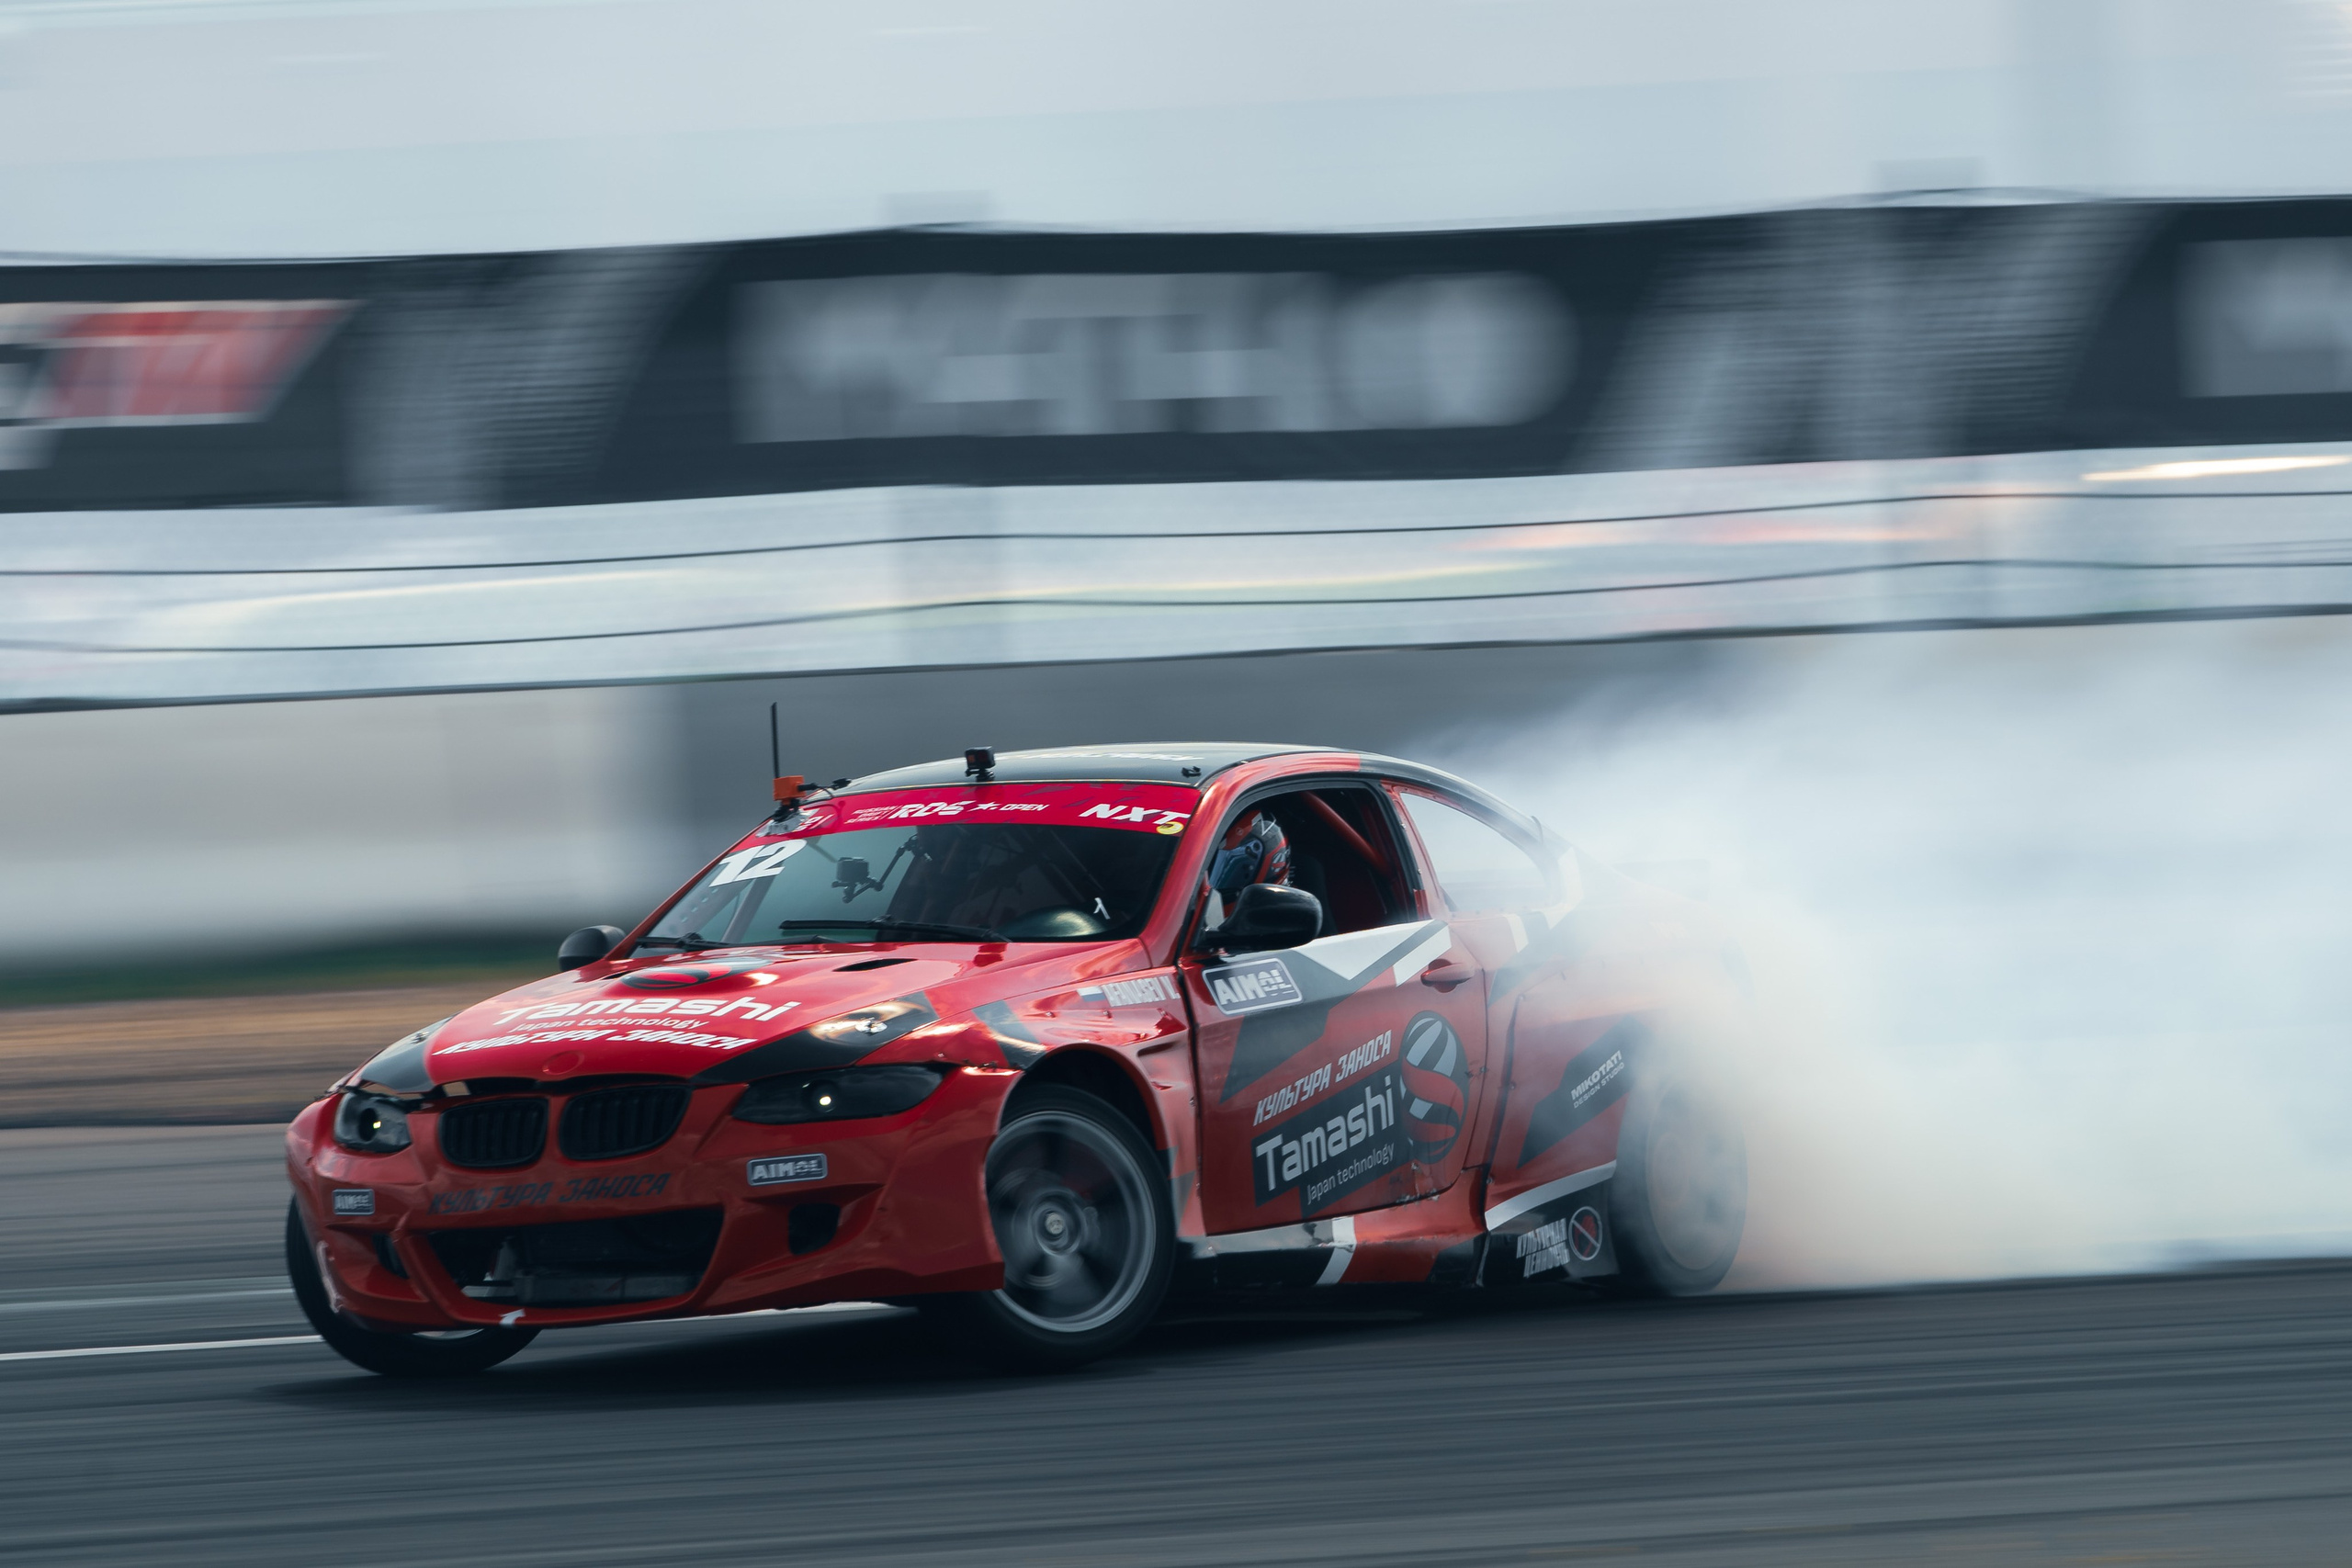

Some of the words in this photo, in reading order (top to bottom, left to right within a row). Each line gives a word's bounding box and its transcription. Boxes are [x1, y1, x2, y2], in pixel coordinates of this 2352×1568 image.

[888, 801, 977, 819] RDS
[999, 804, 1050, 812] OPEN
[1078, 804, 1192, 825] NXT
[708, 839, 807, 887] 12
[1212, 967, 1297, 1006] AIMOL
[492, 997, 802, 1026] Tamashi
[577, 1017, 710, 1030] technology
[605, 1029, 759, 1050] ЗАНОСА
[1253, 1062, 1333, 1127] КУЛЬТУРА
[1335, 1029, 1392, 1084] ЗАНОСА
[1570, 1050, 1623, 1100] MIKOTATI
[1573, 1083, 1601, 1109] DESIGN
[1600, 1062, 1625, 1087] STUDIO
[1255, 1075, 1395, 1192] Tamashi
[752, 1159, 823, 1180] AIMOL
[1306, 1177, 1336, 1205] Japan
[1337, 1142, 1396, 1184] technology
[426, 1181, 555, 1215] КУЛЬТУРА
[558, 1173, 672, 1203] ЗАНОСА
